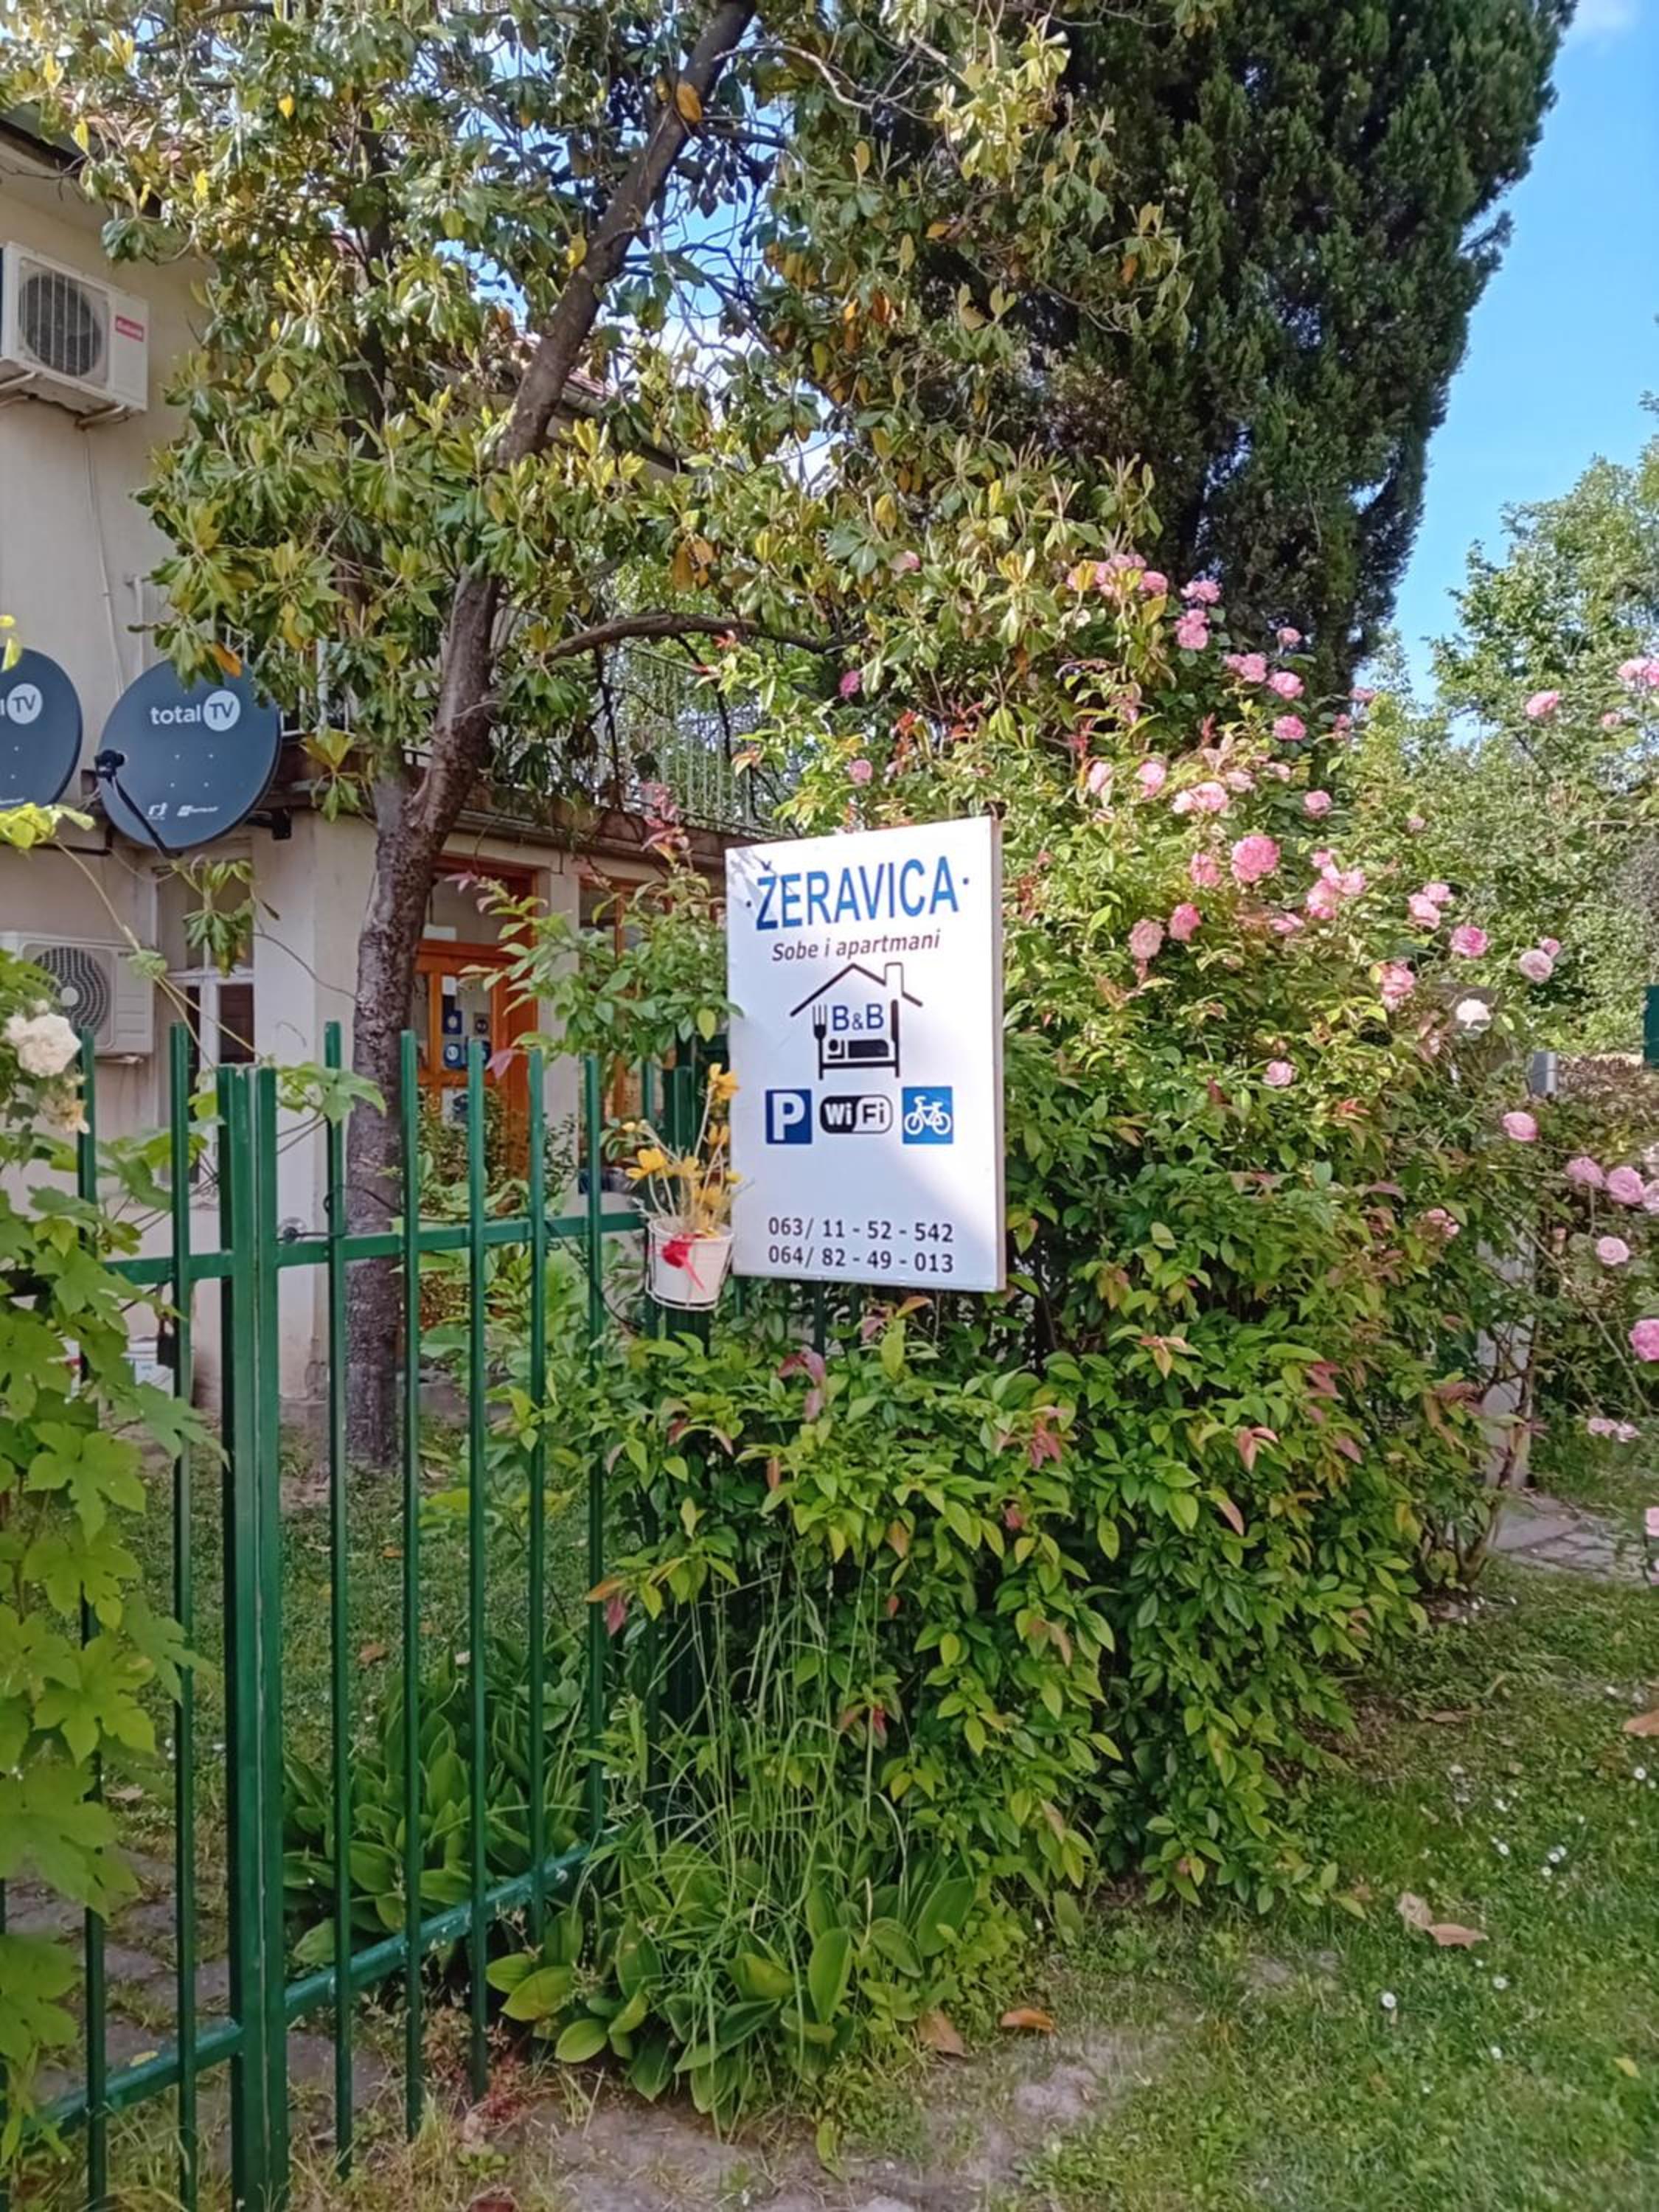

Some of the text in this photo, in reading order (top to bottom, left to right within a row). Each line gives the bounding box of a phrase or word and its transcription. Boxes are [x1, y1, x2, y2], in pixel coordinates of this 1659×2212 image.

[771, 929, 942, 961] Sobe i apartmani
[832, 1003, 884, 1032] B&B
[772, 1092, 805, 1141] P
